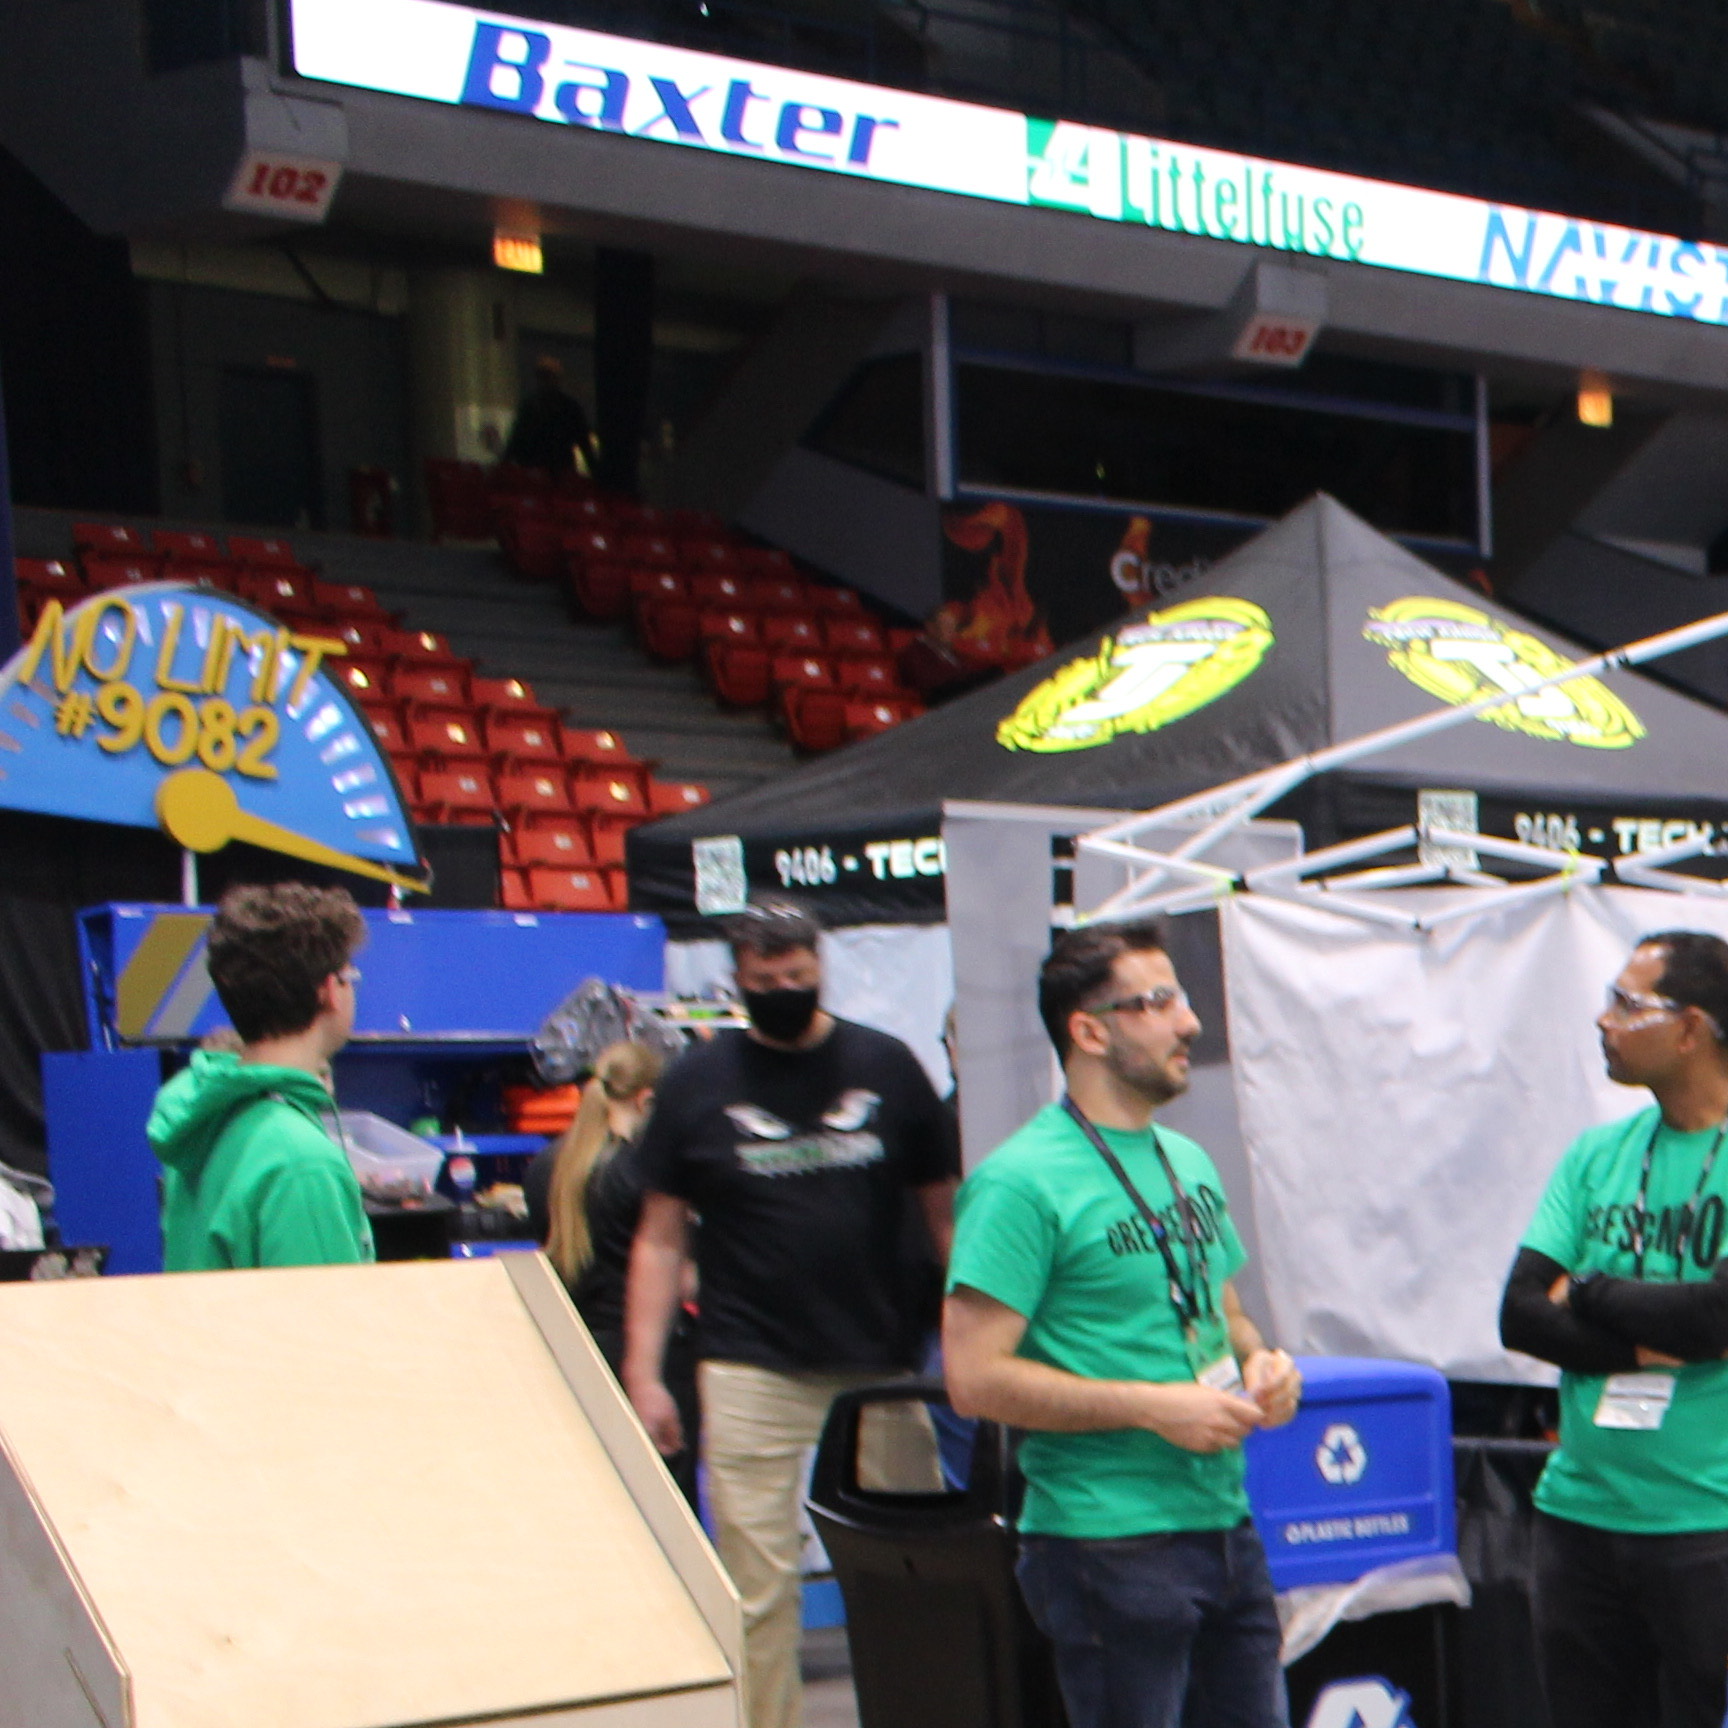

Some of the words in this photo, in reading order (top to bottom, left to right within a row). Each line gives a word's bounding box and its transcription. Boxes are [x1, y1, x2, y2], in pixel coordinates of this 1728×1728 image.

[458, 20, 900, 168] Baxter
[246, 161, 326, 204] 102
[1115, 132, 1365, 260] Littelfuse
[1250, 324, 1308, 355] 103
[18, 599, 136, 694] NO
[154, 603, 348, 704] LIMIT
[54, 681, 279, 779] #9082
[774, 845, 837, 887] 9406
[864, 836, 946, 881] TEC
